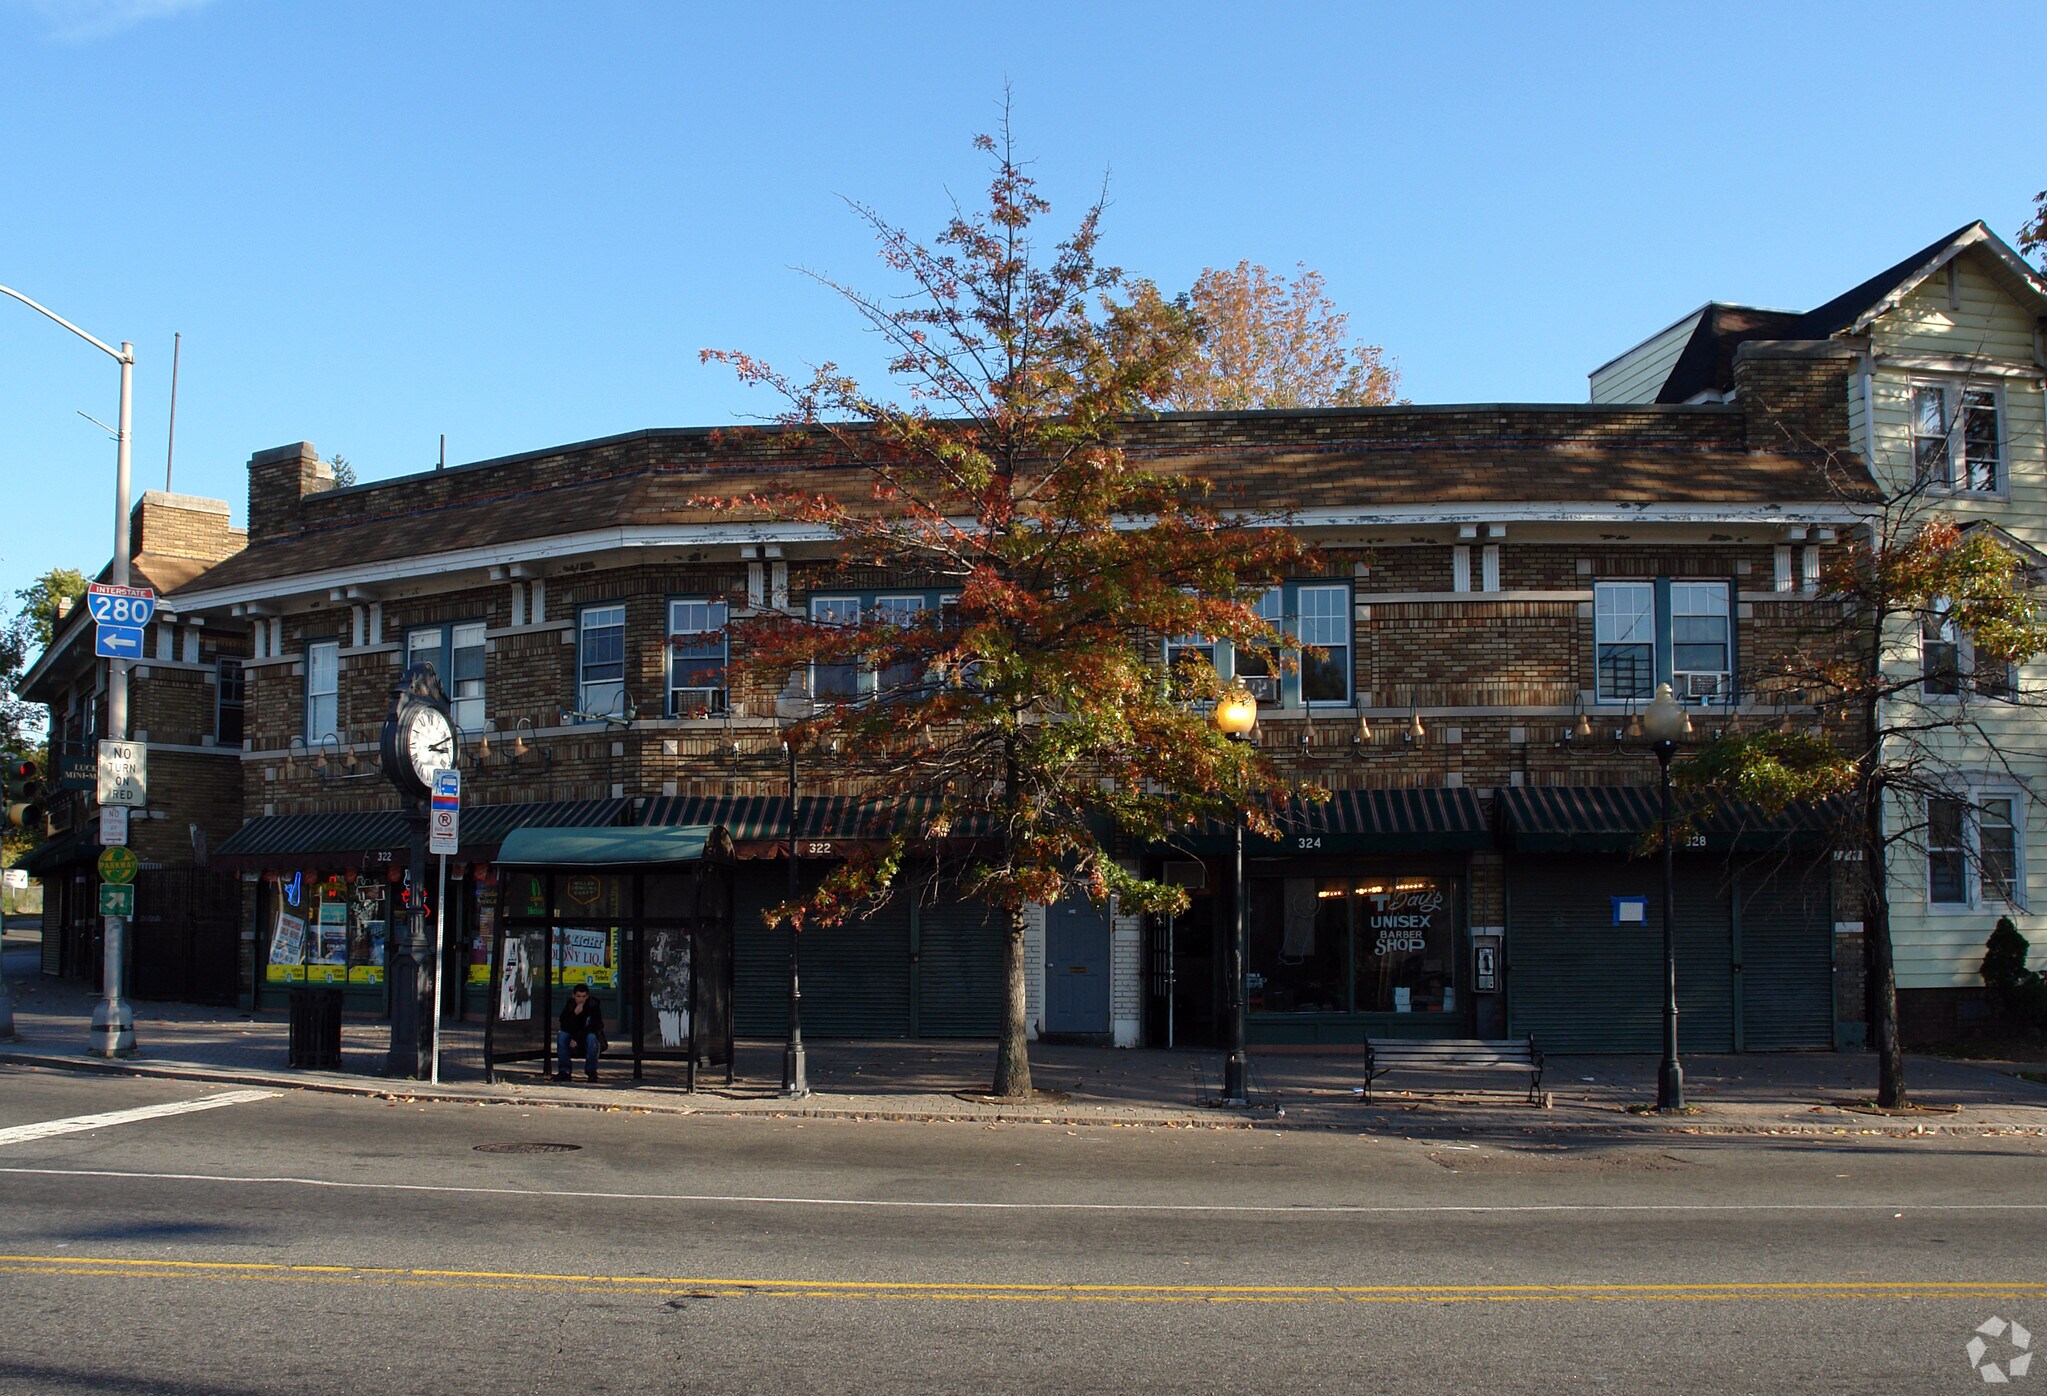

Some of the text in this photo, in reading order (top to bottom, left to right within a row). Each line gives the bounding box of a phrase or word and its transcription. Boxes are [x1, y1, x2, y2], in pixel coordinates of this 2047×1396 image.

[96, 586, 146, 597] INTERSTATE
[96, 597, 149, 623] 280
[114, 748, 131, 759] NO
[108, 762, 136, 773] TURN
[115, 776, 130, 786] ON
[112, 790, 133, 800] RED
[809, 843, 831, 853] 322
[1298, 837, 1322, 849] 324
[377, 852, 392, 862] 322
[98, 861, 136, 870] PARKWAY
[1379, 930, 1422, 939] BARBER
[571, 935, 604, 948] LIGHT
[1374, 938, 1426, 956] SHOP
[583, 952, 602, 967] LIQ.
